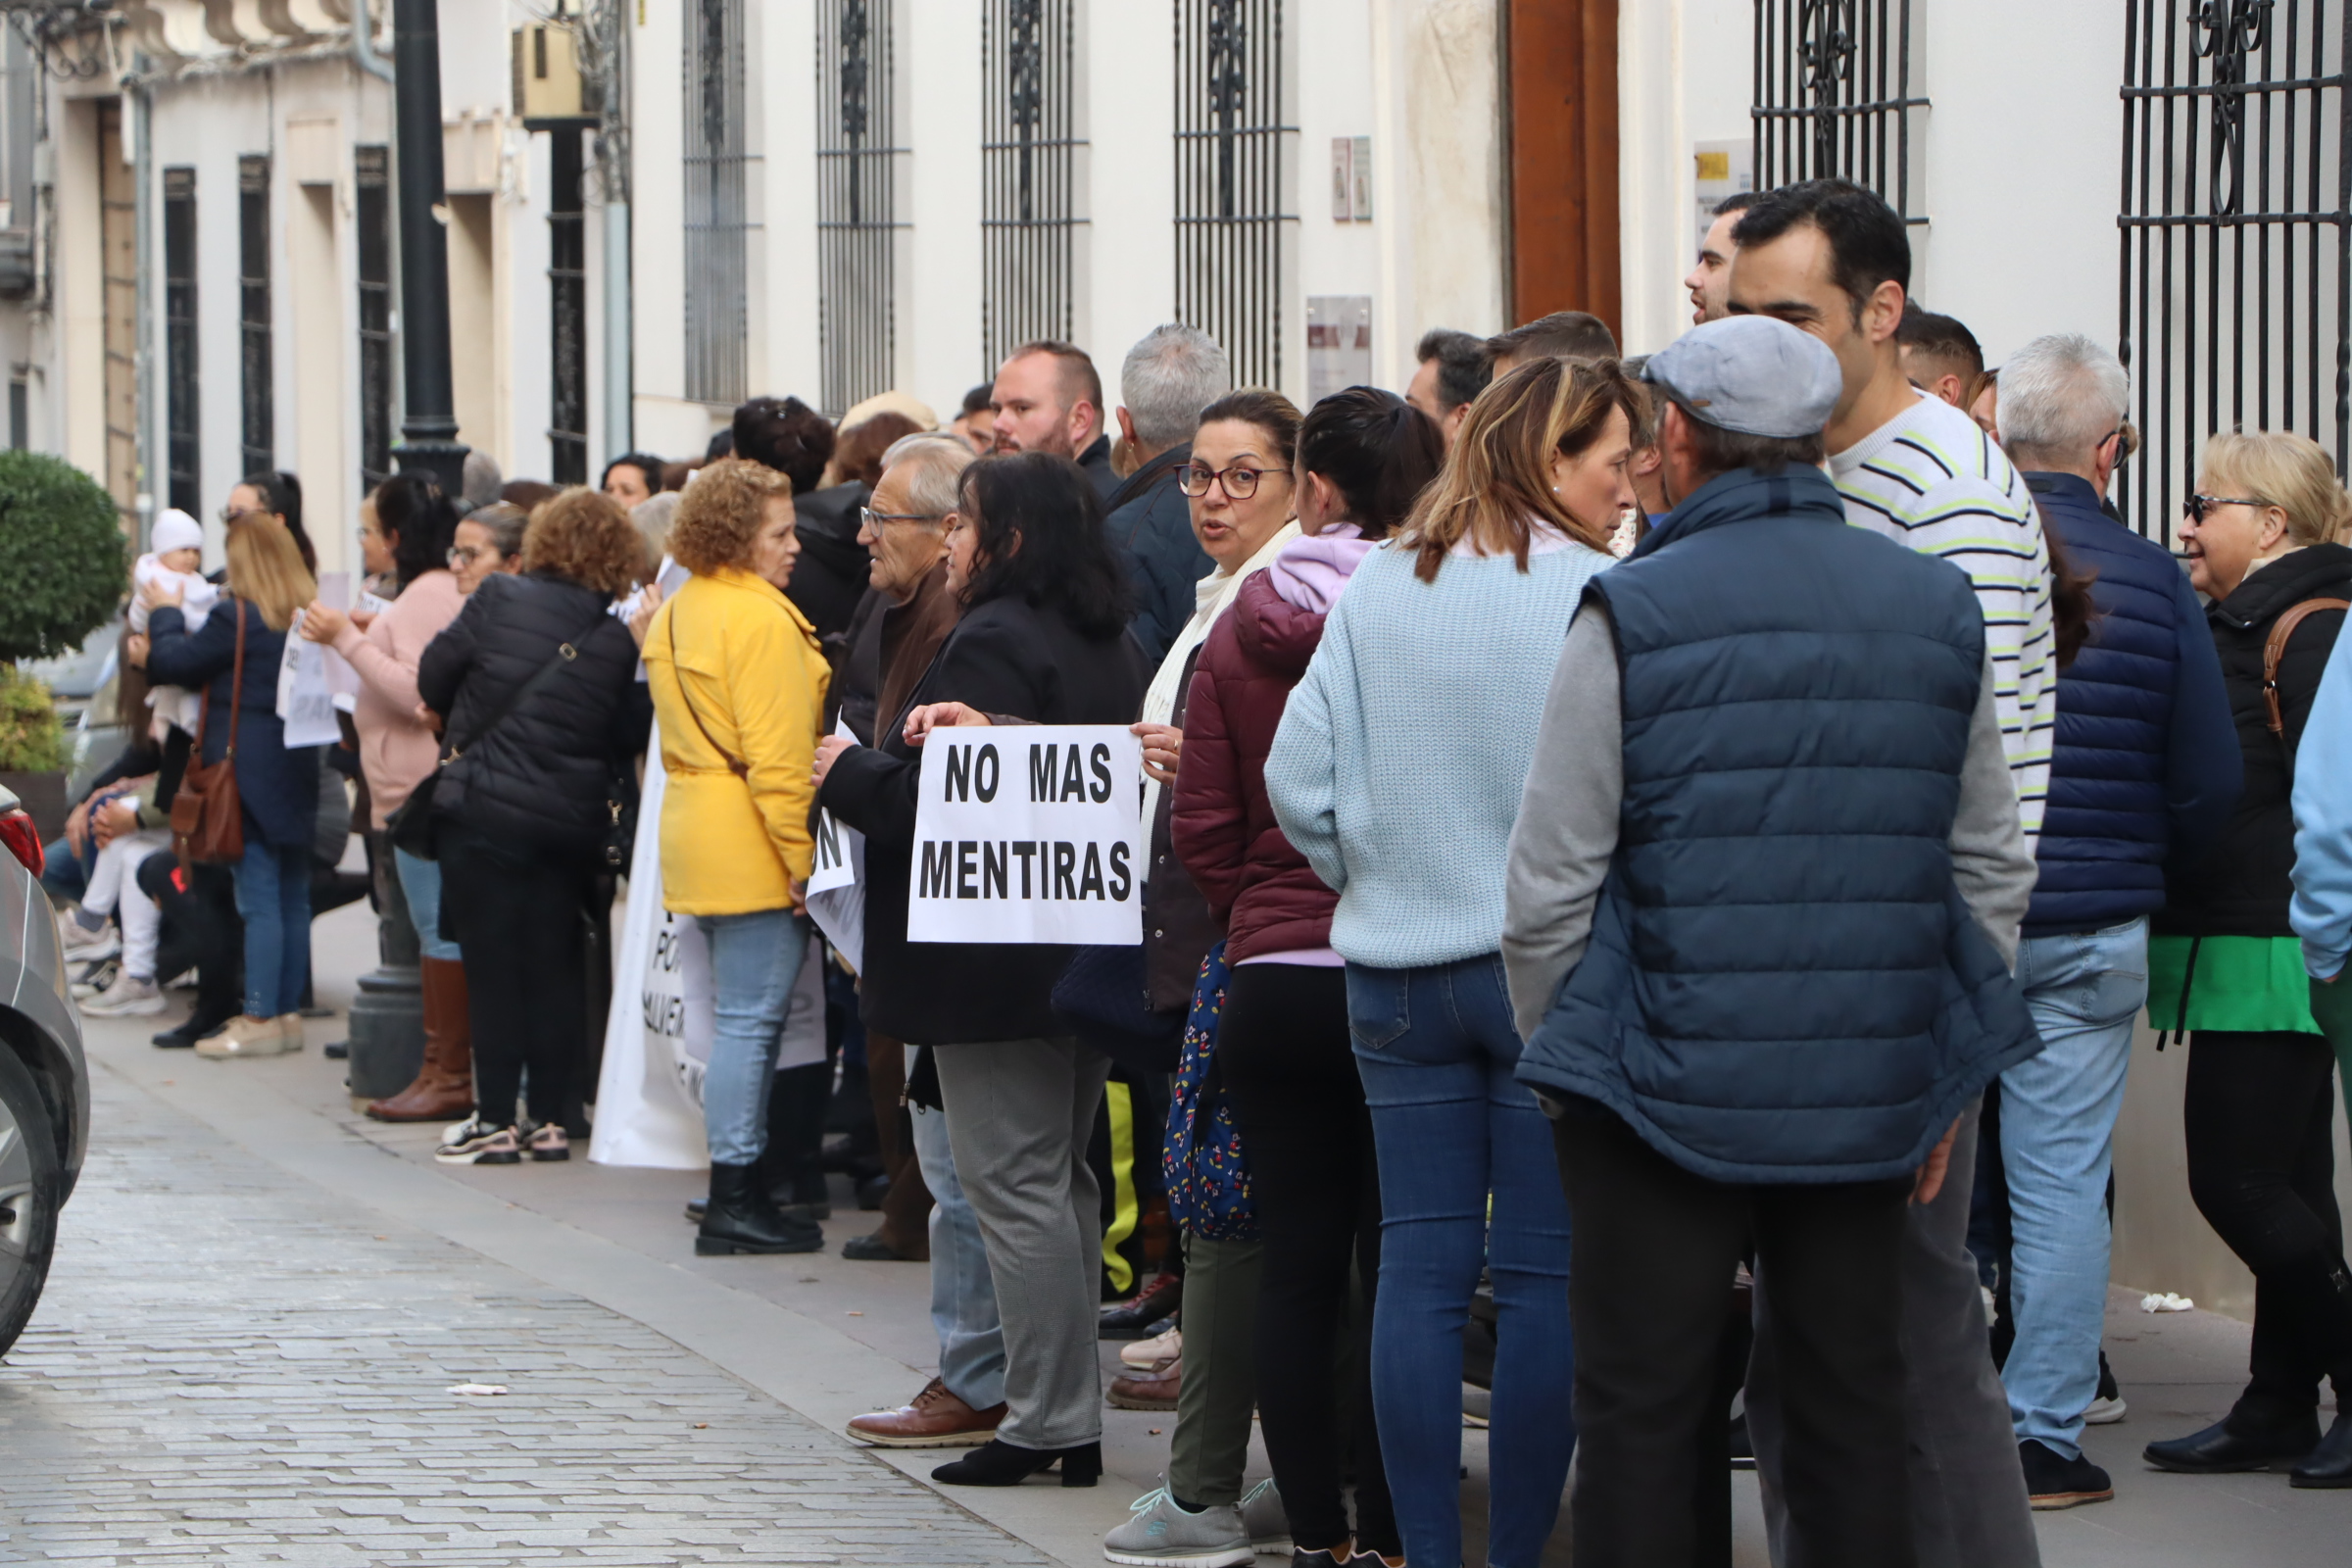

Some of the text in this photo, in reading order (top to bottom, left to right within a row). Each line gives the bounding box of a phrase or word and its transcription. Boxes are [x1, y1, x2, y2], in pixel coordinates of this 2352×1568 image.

[944, 742, 1112, 804] NO MAS
[918, 840, 1132, 902] MENTIRAS
